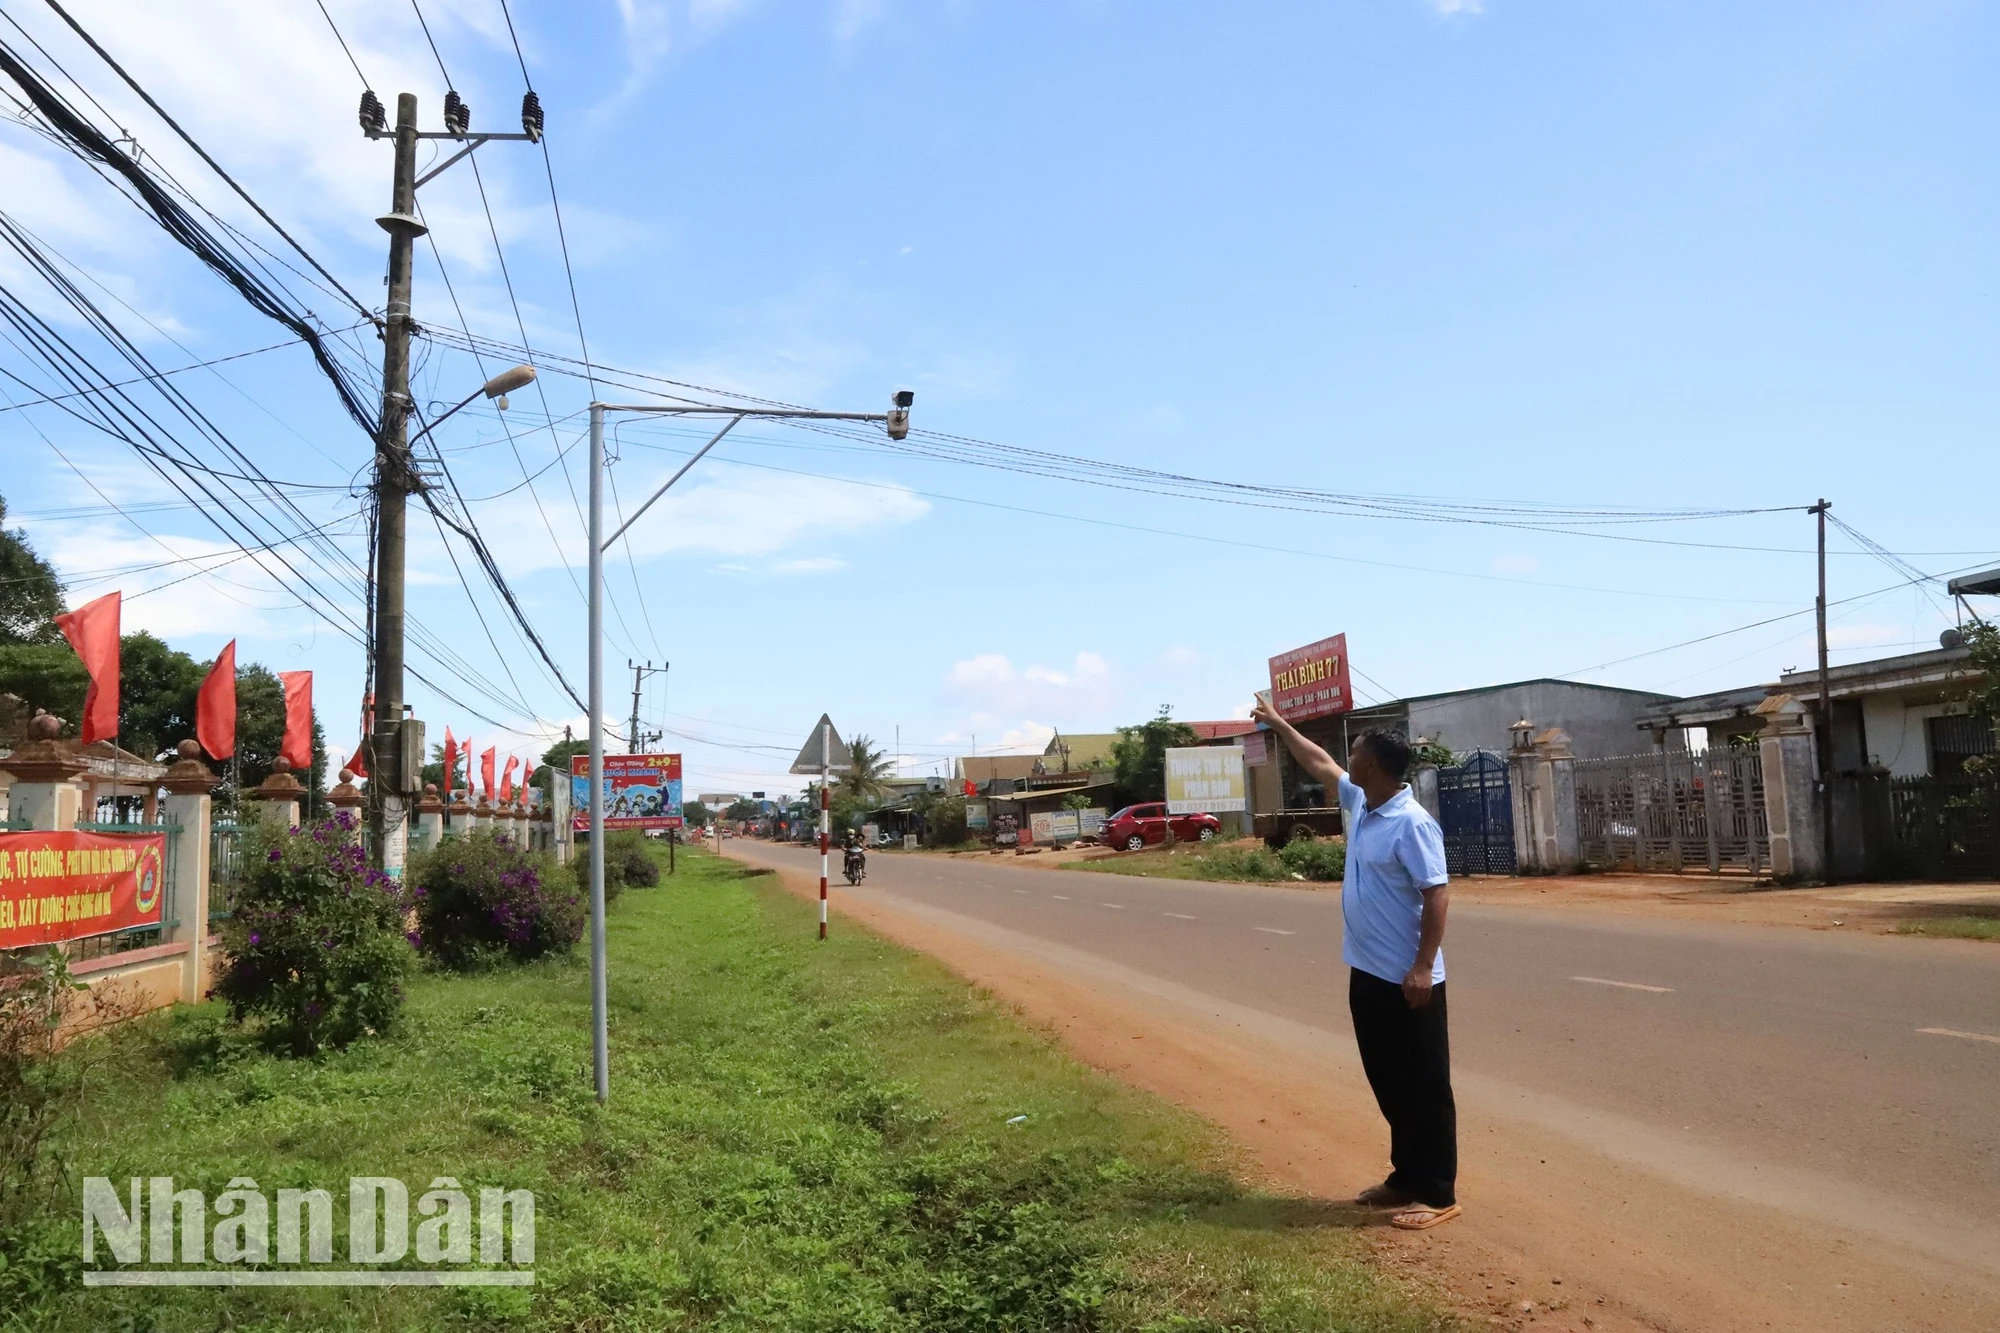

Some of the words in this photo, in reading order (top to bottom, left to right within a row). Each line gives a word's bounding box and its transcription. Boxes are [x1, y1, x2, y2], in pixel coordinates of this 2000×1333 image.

[1275, 662, 1299, 692] THÁI
[1300, 658, 1325, 686] BÌNH
[1326, 655, 1339, 678] 77
[15, 848, 28, 884] TỰ
[18, 893, 38, 927] XÂY
[39, 894, 65, 930] DỰNG
